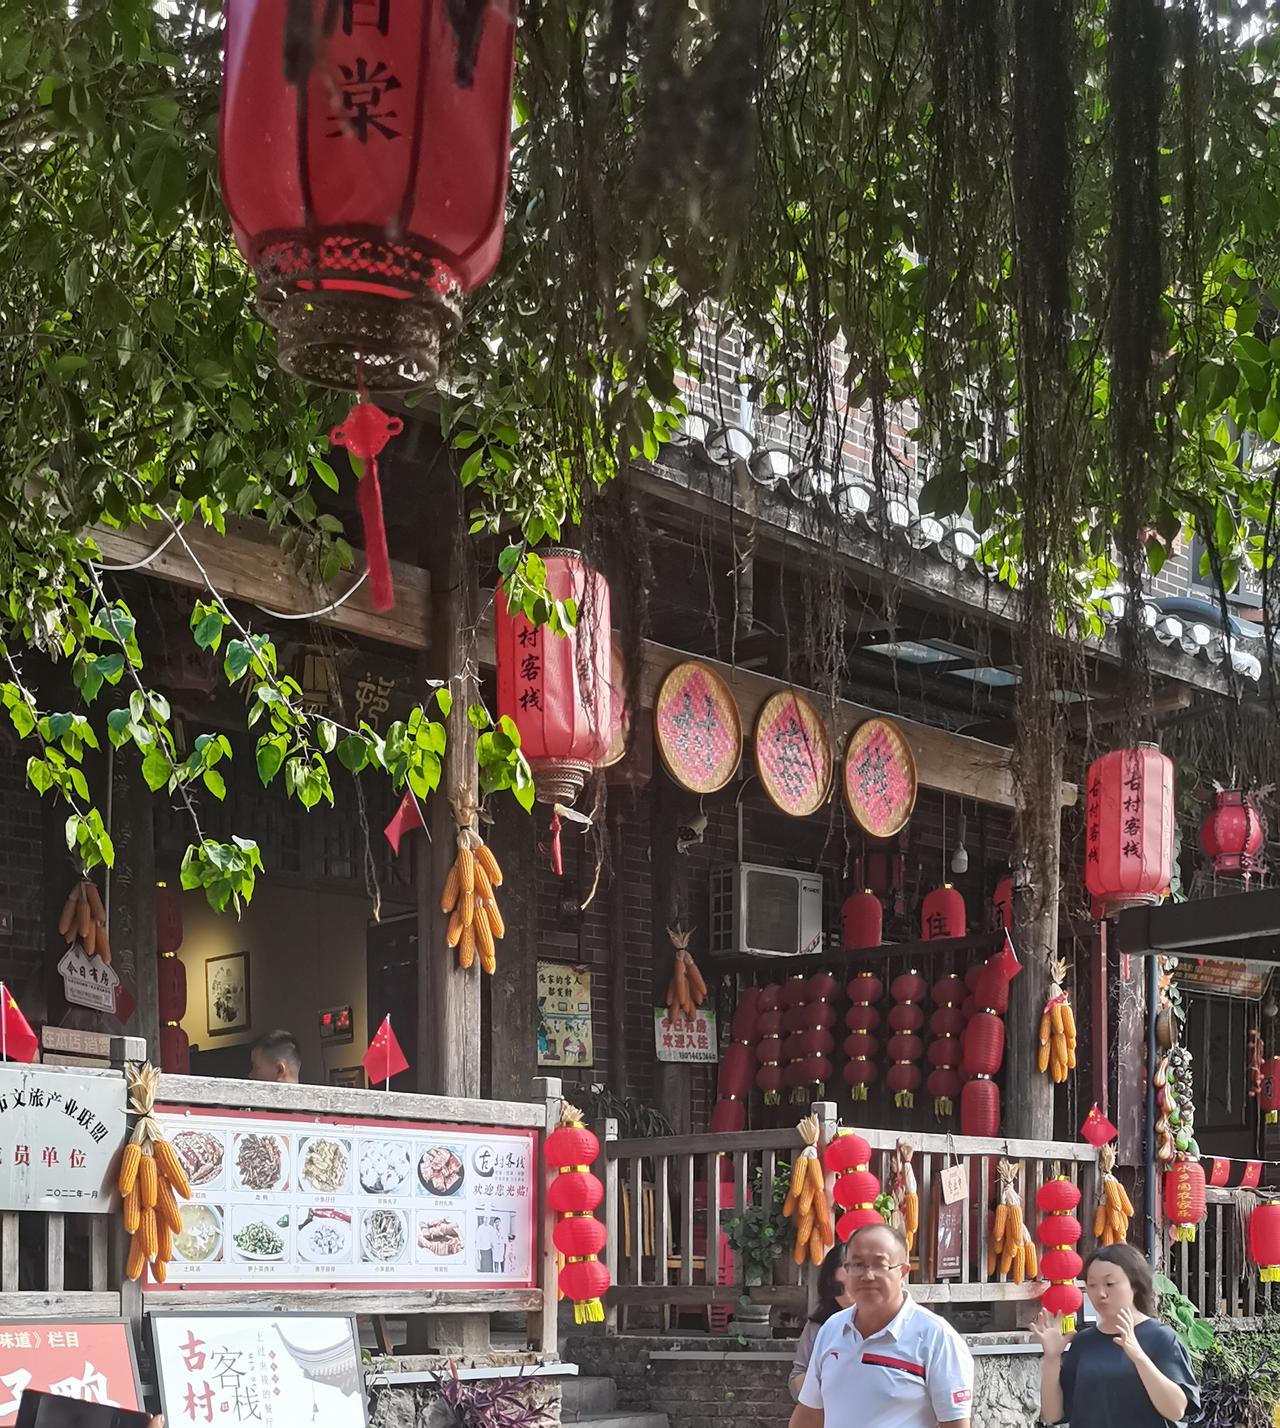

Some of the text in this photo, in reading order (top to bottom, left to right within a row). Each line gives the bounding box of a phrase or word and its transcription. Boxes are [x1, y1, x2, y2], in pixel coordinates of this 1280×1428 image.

[1122, 774, 1142, 859] 古村客栈
[661, 1017, 706, 1033] 今日有房
[663, 1033, 708, 1050] 欢迎入住
[0, 1144, 86, 1168] 员单位
[179, 1330, 216, 1423] 古村
[211, 1345, 262, 1422] 客栈
